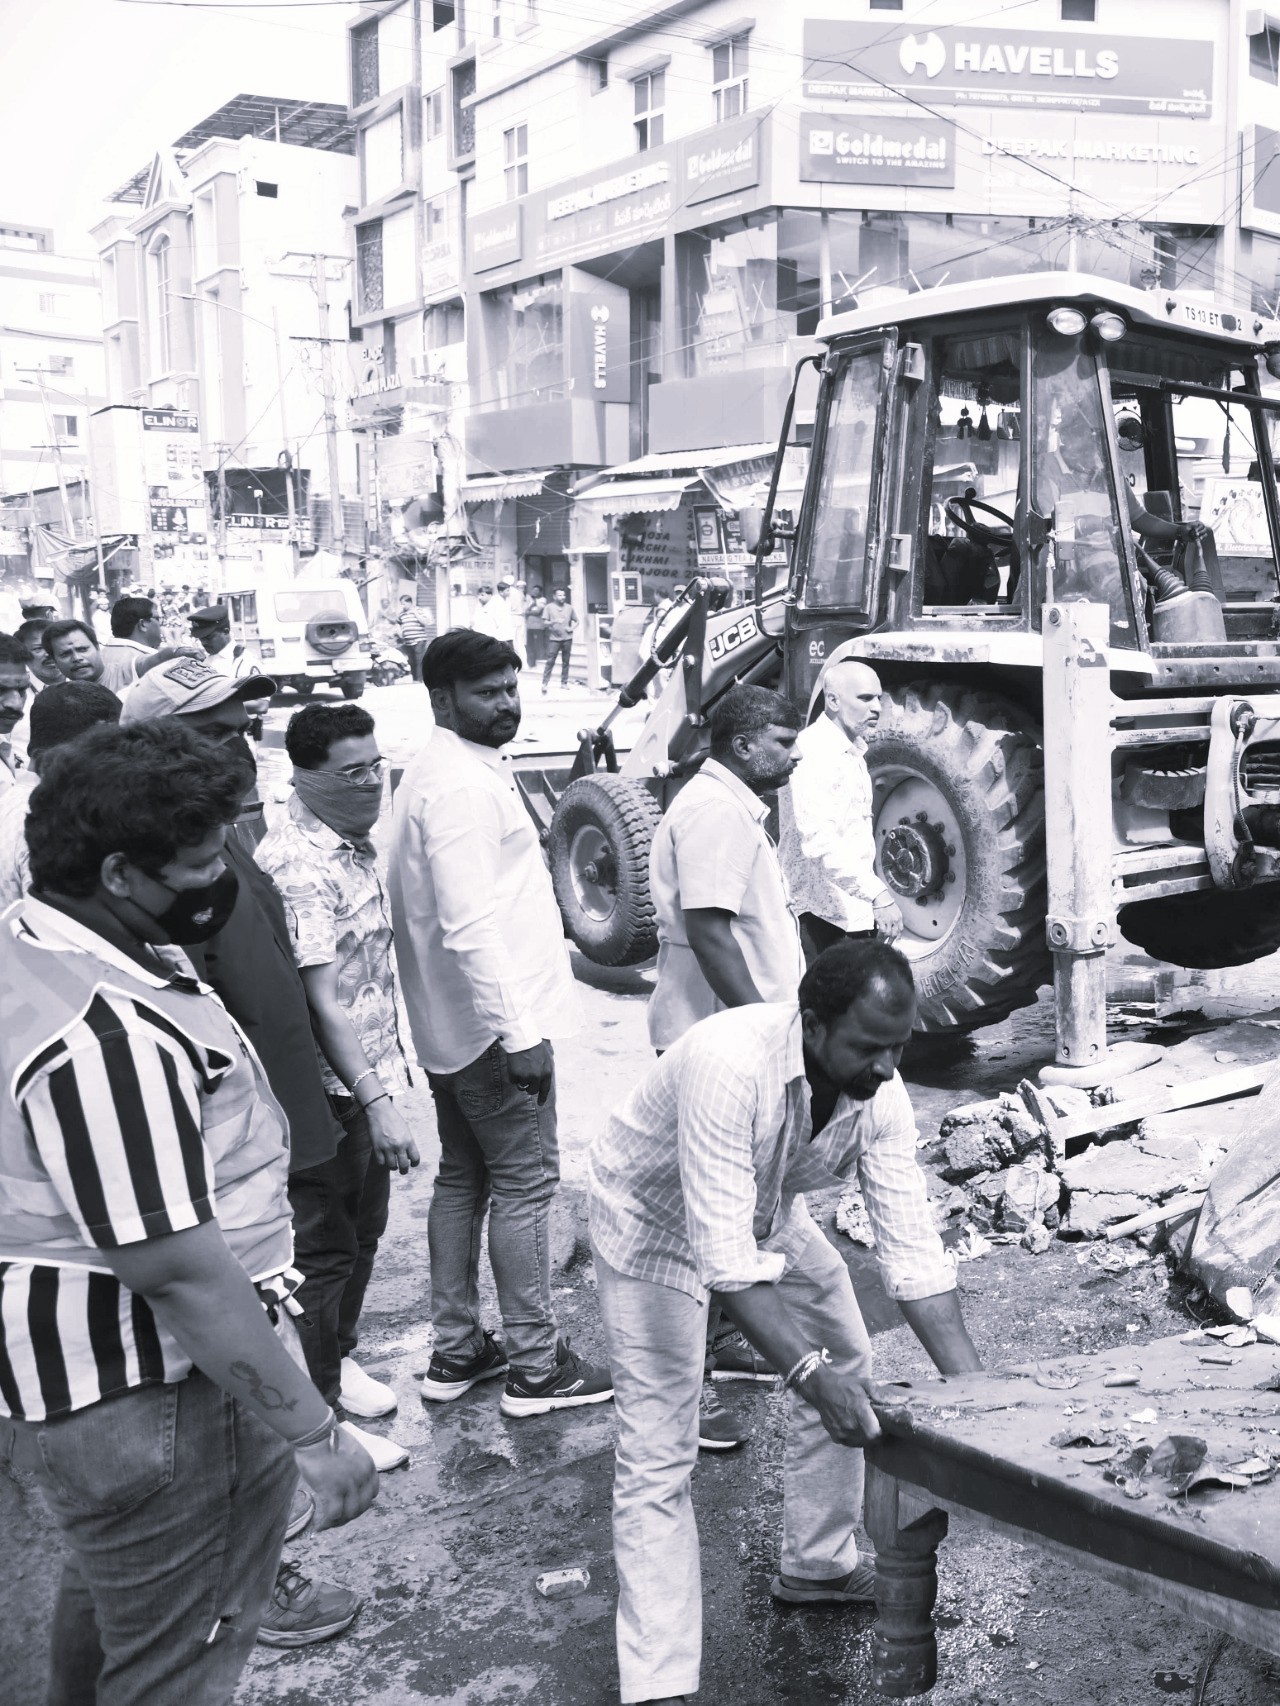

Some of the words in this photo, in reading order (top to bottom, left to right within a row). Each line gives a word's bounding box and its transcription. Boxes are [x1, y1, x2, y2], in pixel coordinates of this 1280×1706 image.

[954, 42, 1119, 79] HAVELLS
[836, 132, 947, 161] Goldmedal
[981, 136, 1068, 158] DEEPAK
[1072, 140, 1200, 166] MARKETING
[836, 156, 869, 166] SWITCH
[872, 158, 884, 167] TO
[886, 158, 903, 168] THE
[904, 159, 946, 169] AMAZING
[1185, 306, 1196, 321] TS
[1198, 310, 1207, 323] 13
[1209, 313, 1219, 326] ET
[593, 324, 607, 389] HAVELLS
[711, 615, 758, 660] JCB
